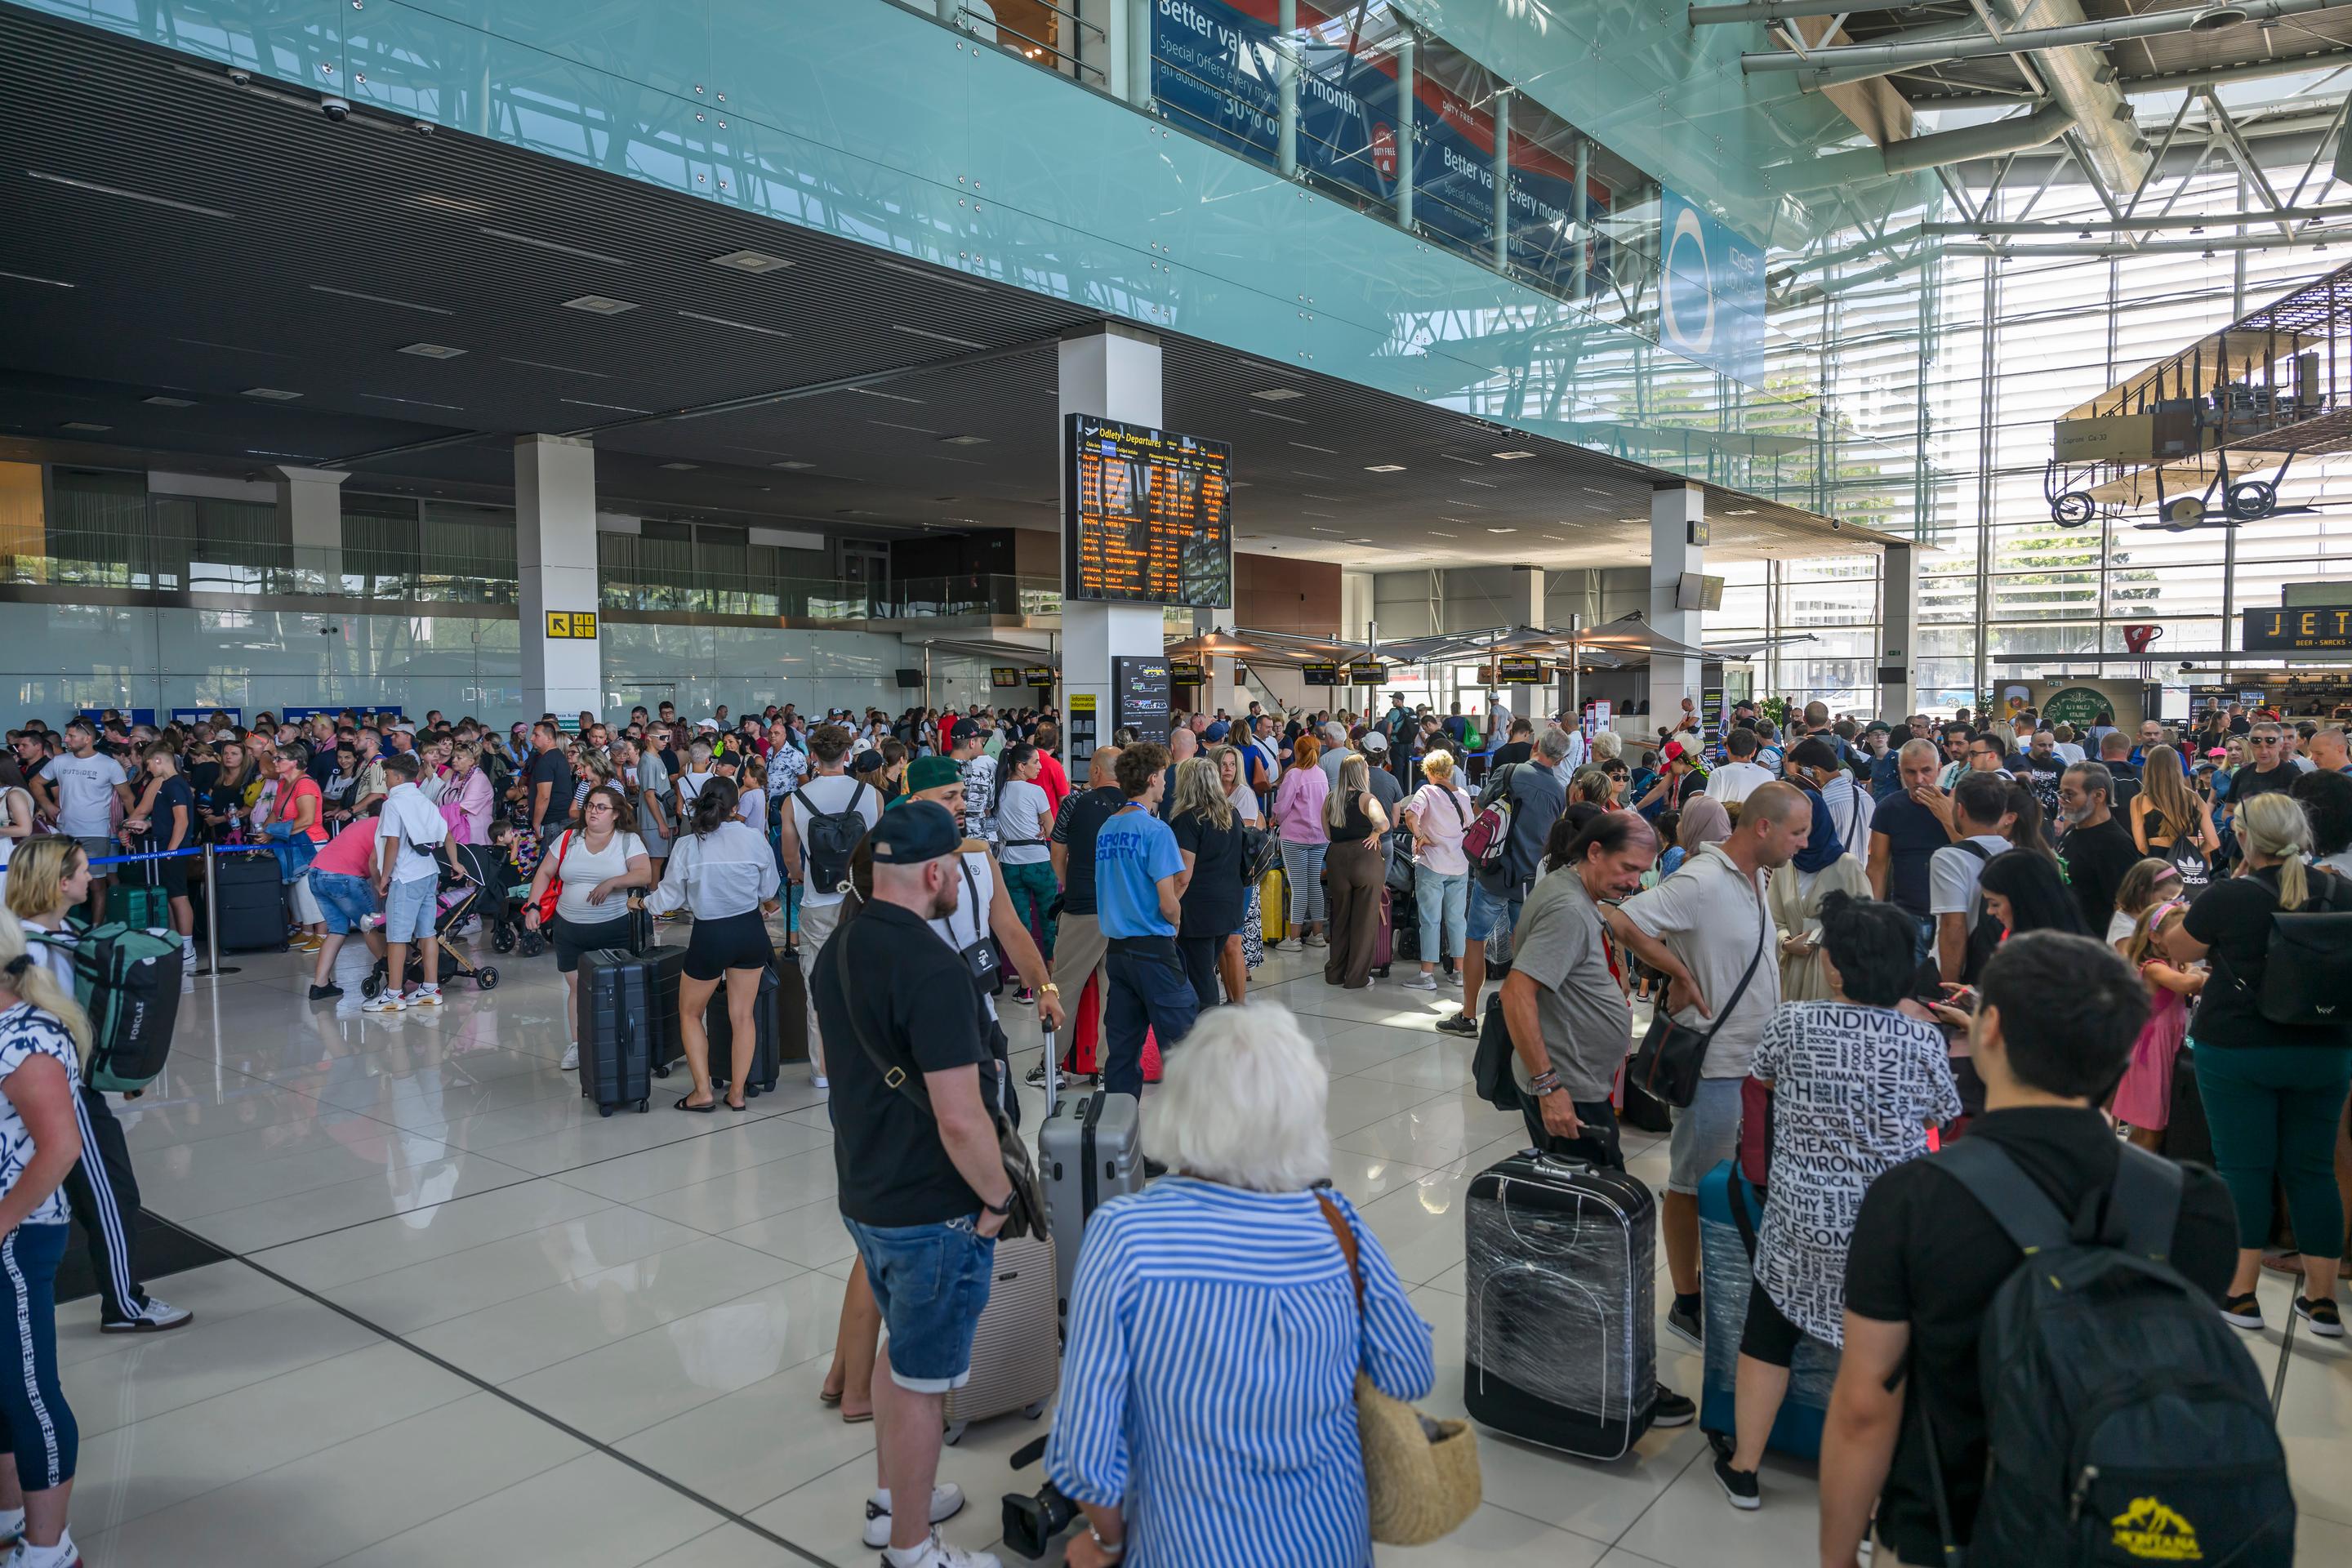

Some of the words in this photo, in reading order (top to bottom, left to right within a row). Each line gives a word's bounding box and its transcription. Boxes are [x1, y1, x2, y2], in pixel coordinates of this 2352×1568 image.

[1159, 0, 1214, 38] Better
[1160, 34, 1194, 63] Special
[1196, 53, 1225, 79] Offers
[1227, 71, 1253, 96] every
[1224, 88, 1262, 129] 30%
[1312, 78, 1361, 118] month.
[1442, 100, 1458, 117] DUTY
[1459, 110, 1474, 125] FREE
[1374, 148, 1384, 156] DUTY
[1385, 148, 1396, 156] FREE
[1444, 147, 1477, 180] Better
[1444, 181, 1466, 201] Special
[1467, 193, 1484, 209] Offers
[1729, 246, 1755, 275] IQOS
[1726, 270, 1757, 301] LOUNGE
[1099, 428, 1121, 443] Odlety
[1125, 433, 1161, 448] Departures
[62, 768, 97, 777] OUTSIDER
[2182, 875, 2208, 884] didas
[130, 1001, 145, 1040] FORCLAZ
[1794, 1011, 1806, 1051] ENERGY
[1806, 1027, 1861, 1040] RESOURCE
[1864, 1034, 1877, 1072] SPORT
[1879, 1036, 1899, 1046] LIFE
[1851, 1042, 1861, 1071] FOOD
[1815, 1069, 1865, 1084] HUMAN
[1878, 1048, 1900, 1138] VITAMINS
[1791, 1112, 1851, 1129] DOCTOR
[1851, 1087, 1869, 1147] MEDICAL
[1793, 1137, 1852, 1155] HEART
[1793, 1184, 1820, 1196] GOOD
[1799, 1171, 1859, 1187] MEDICAL
[1793, 1209, 1820, 1226] LIFE
[1823, 1190, 1836, 1228] HEART
[1848, 1191, 1862, 1217] DIET
[1816, 1285, 1828, 1321] ENERGY
